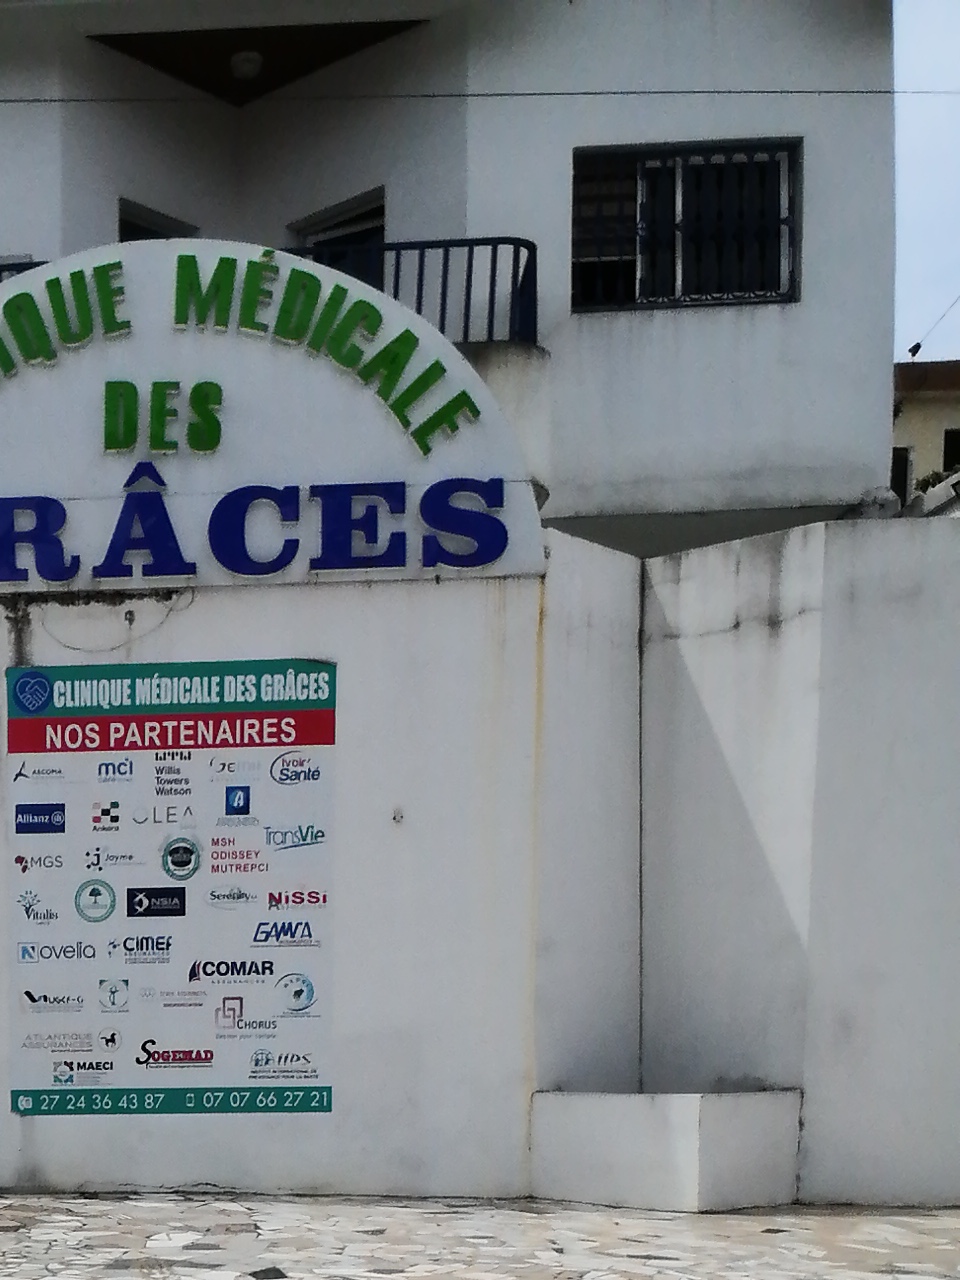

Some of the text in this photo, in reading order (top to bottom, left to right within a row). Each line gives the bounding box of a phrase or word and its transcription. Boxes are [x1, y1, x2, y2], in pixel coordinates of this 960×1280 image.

[174, 248, 481, 457] MÉDICALE
[104, 380, 224, 455] DES
[52, 668, 330, 709] CLINIQUE MÉDICALE DES GRÂCES
[45, 717, 296, 749] NOS PARTENAIRES
[155, 766, 181, 775] Willis
[279, 767, 321, 782] Santé
[155, 776, 190, 786] Towers
[155, 786, 191, 796] Watson
[16, 814, 50, 824] Allianz
[264, 824, 325, 846] TransVie
[211, 838, 236, 847] MSH
[211, 851, 260, 860] ODISSEY
[211, 864, 269, 874] MUTREPCI
[202, 960, 274, 977] COMAR
[76, 1061, 114, 1071] MAECI
[41, 1091, 327, 1110] 27 24 36 43 87 07 07 66 27 21
